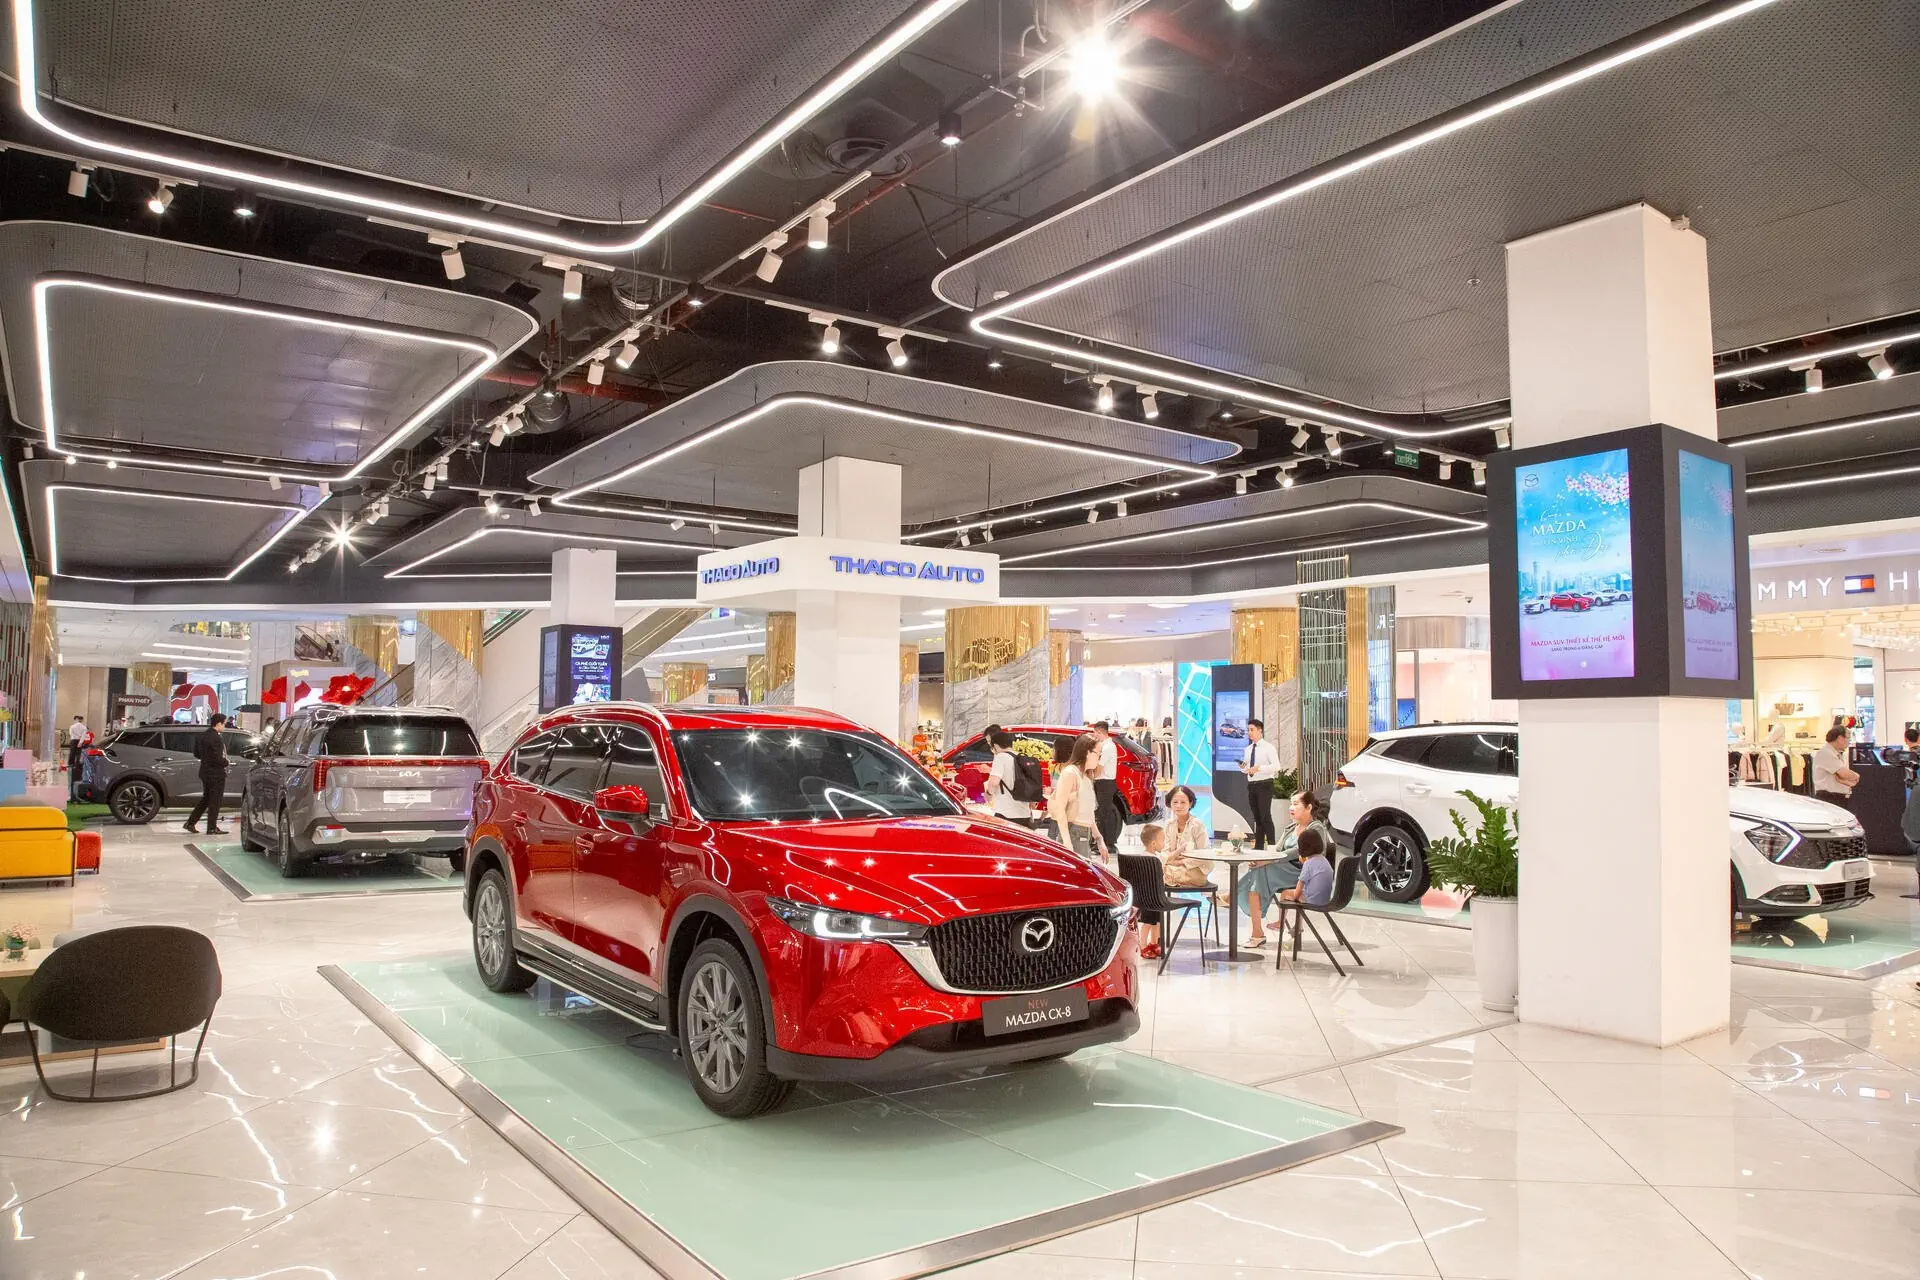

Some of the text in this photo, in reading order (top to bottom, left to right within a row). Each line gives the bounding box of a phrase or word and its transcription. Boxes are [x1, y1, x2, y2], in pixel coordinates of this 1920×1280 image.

[1532, 519, 1586, 537] MAZDA
[700, 556, 780, 584] THACO AUTO
[829, 555, 985, 584] THACO AUTO
[1028, 999, 1048, 1010] NEW
[1005, 1005, 1072, 1027] MAZDA CX-8
